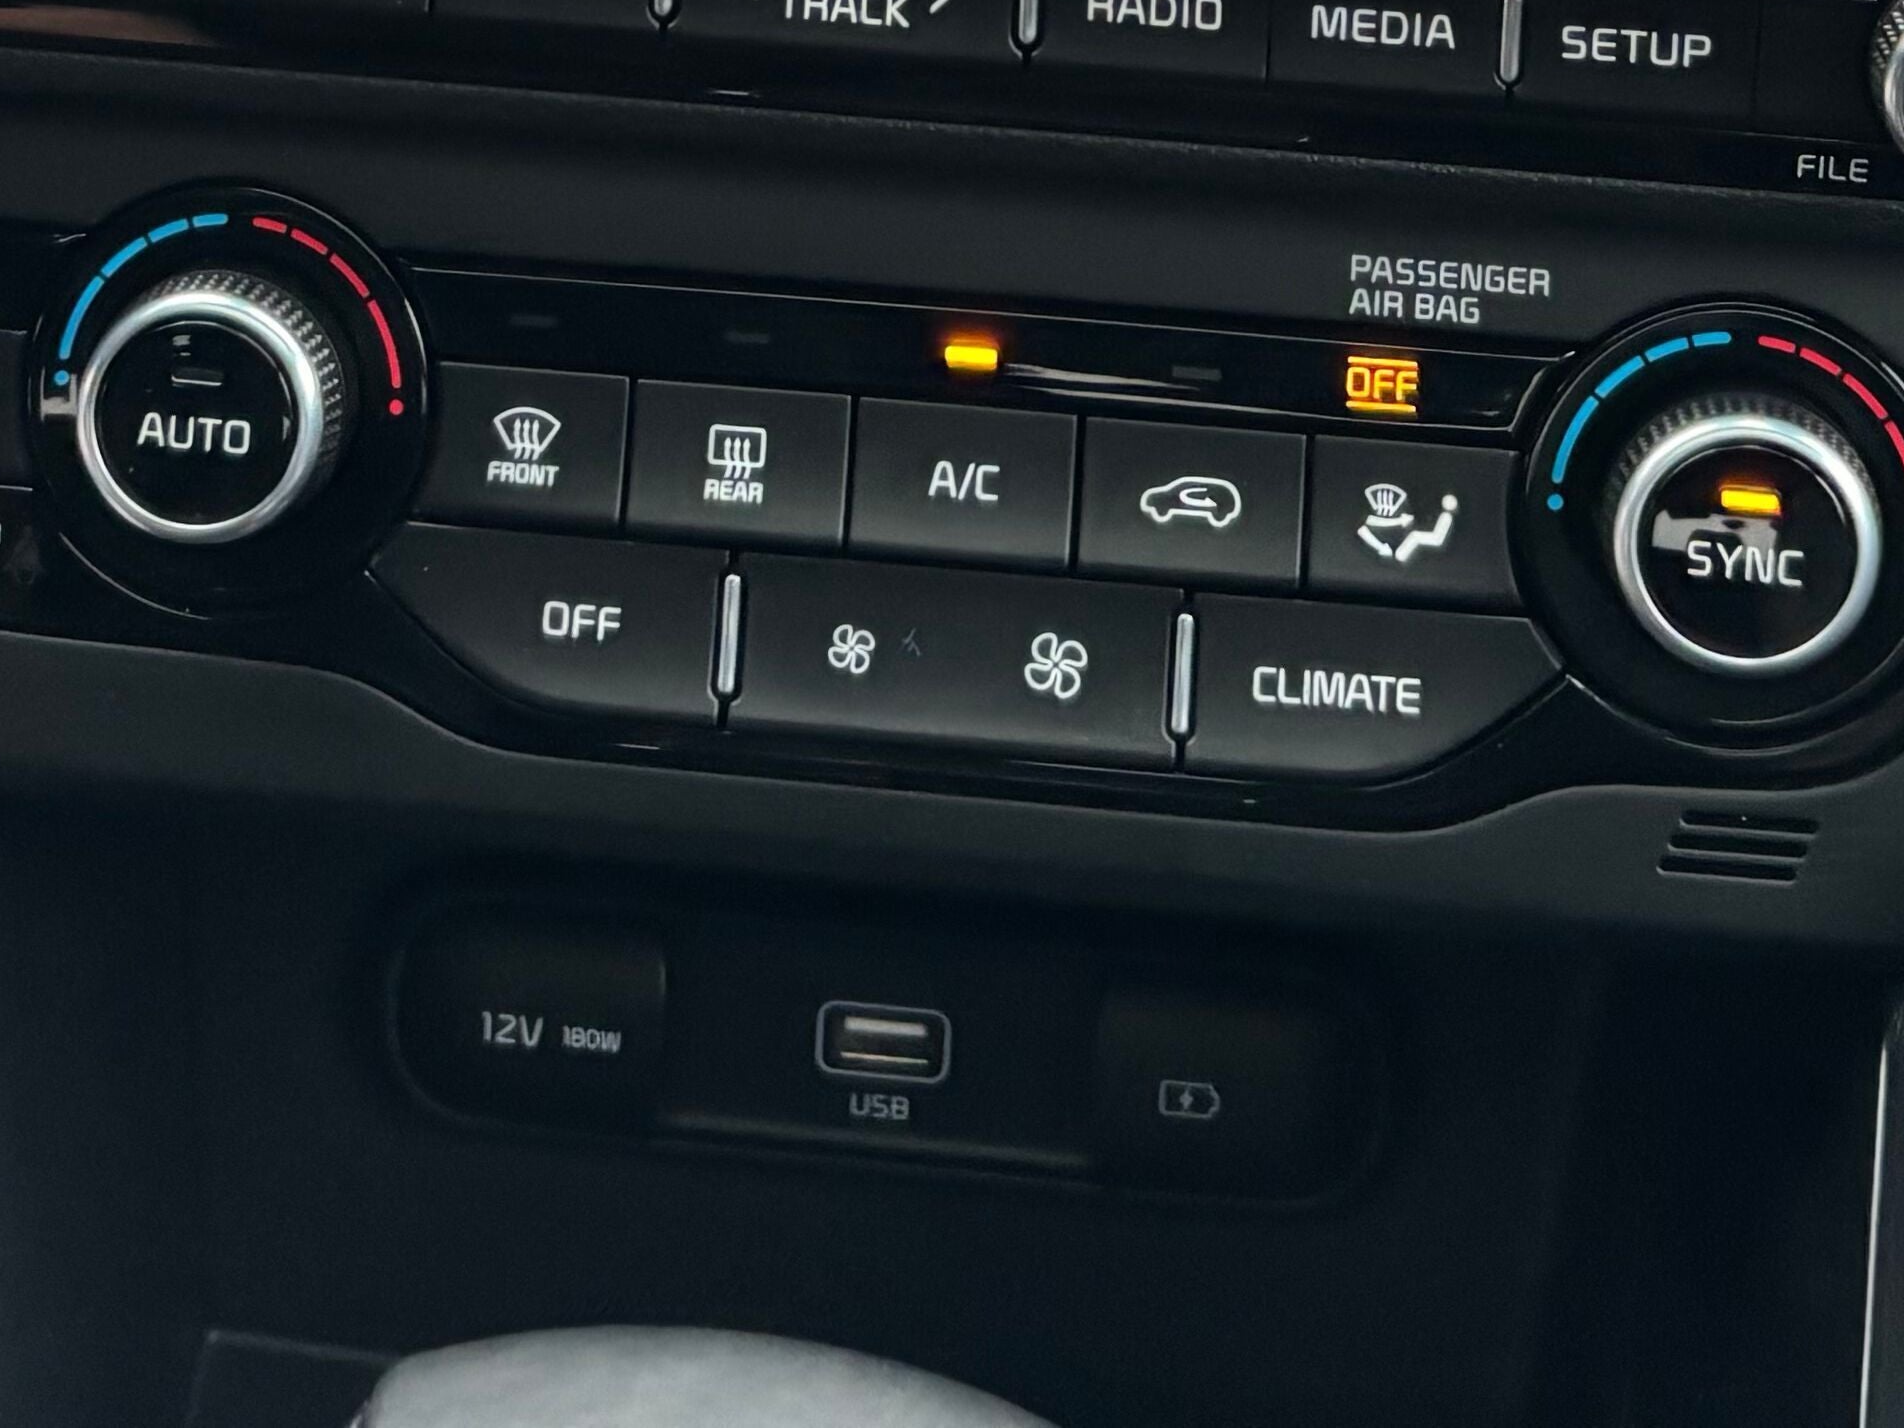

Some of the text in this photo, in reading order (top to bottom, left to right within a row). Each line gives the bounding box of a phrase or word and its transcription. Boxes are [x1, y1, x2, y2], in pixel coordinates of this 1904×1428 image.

[1312, 5, 1455, 48] MEDIA
[1562, 26, 1711, 67] SETUP
[1797, 155, 1868, 182] FILE
[1350, 255, 1551, 299] PASSENGER
[1349, 288, 1479, 323] AIR BAG
[1346, 370, 1419, 401] OFF
[138, 412, 250, 454] AUTO
[488, 461, 559, 486] FRONT
[703, 478, 764, 504] REAR
[929, 461, 1000, 501] A/C
[1687, 540, 1805, 587] SYNC
[543, 601, 621, 641] OFF
[1253, 667, 1420, 714] CLIMATE
[483, 1012, 621, 1052] 12V 180W
[850, 1094, 909, 1120] USB
